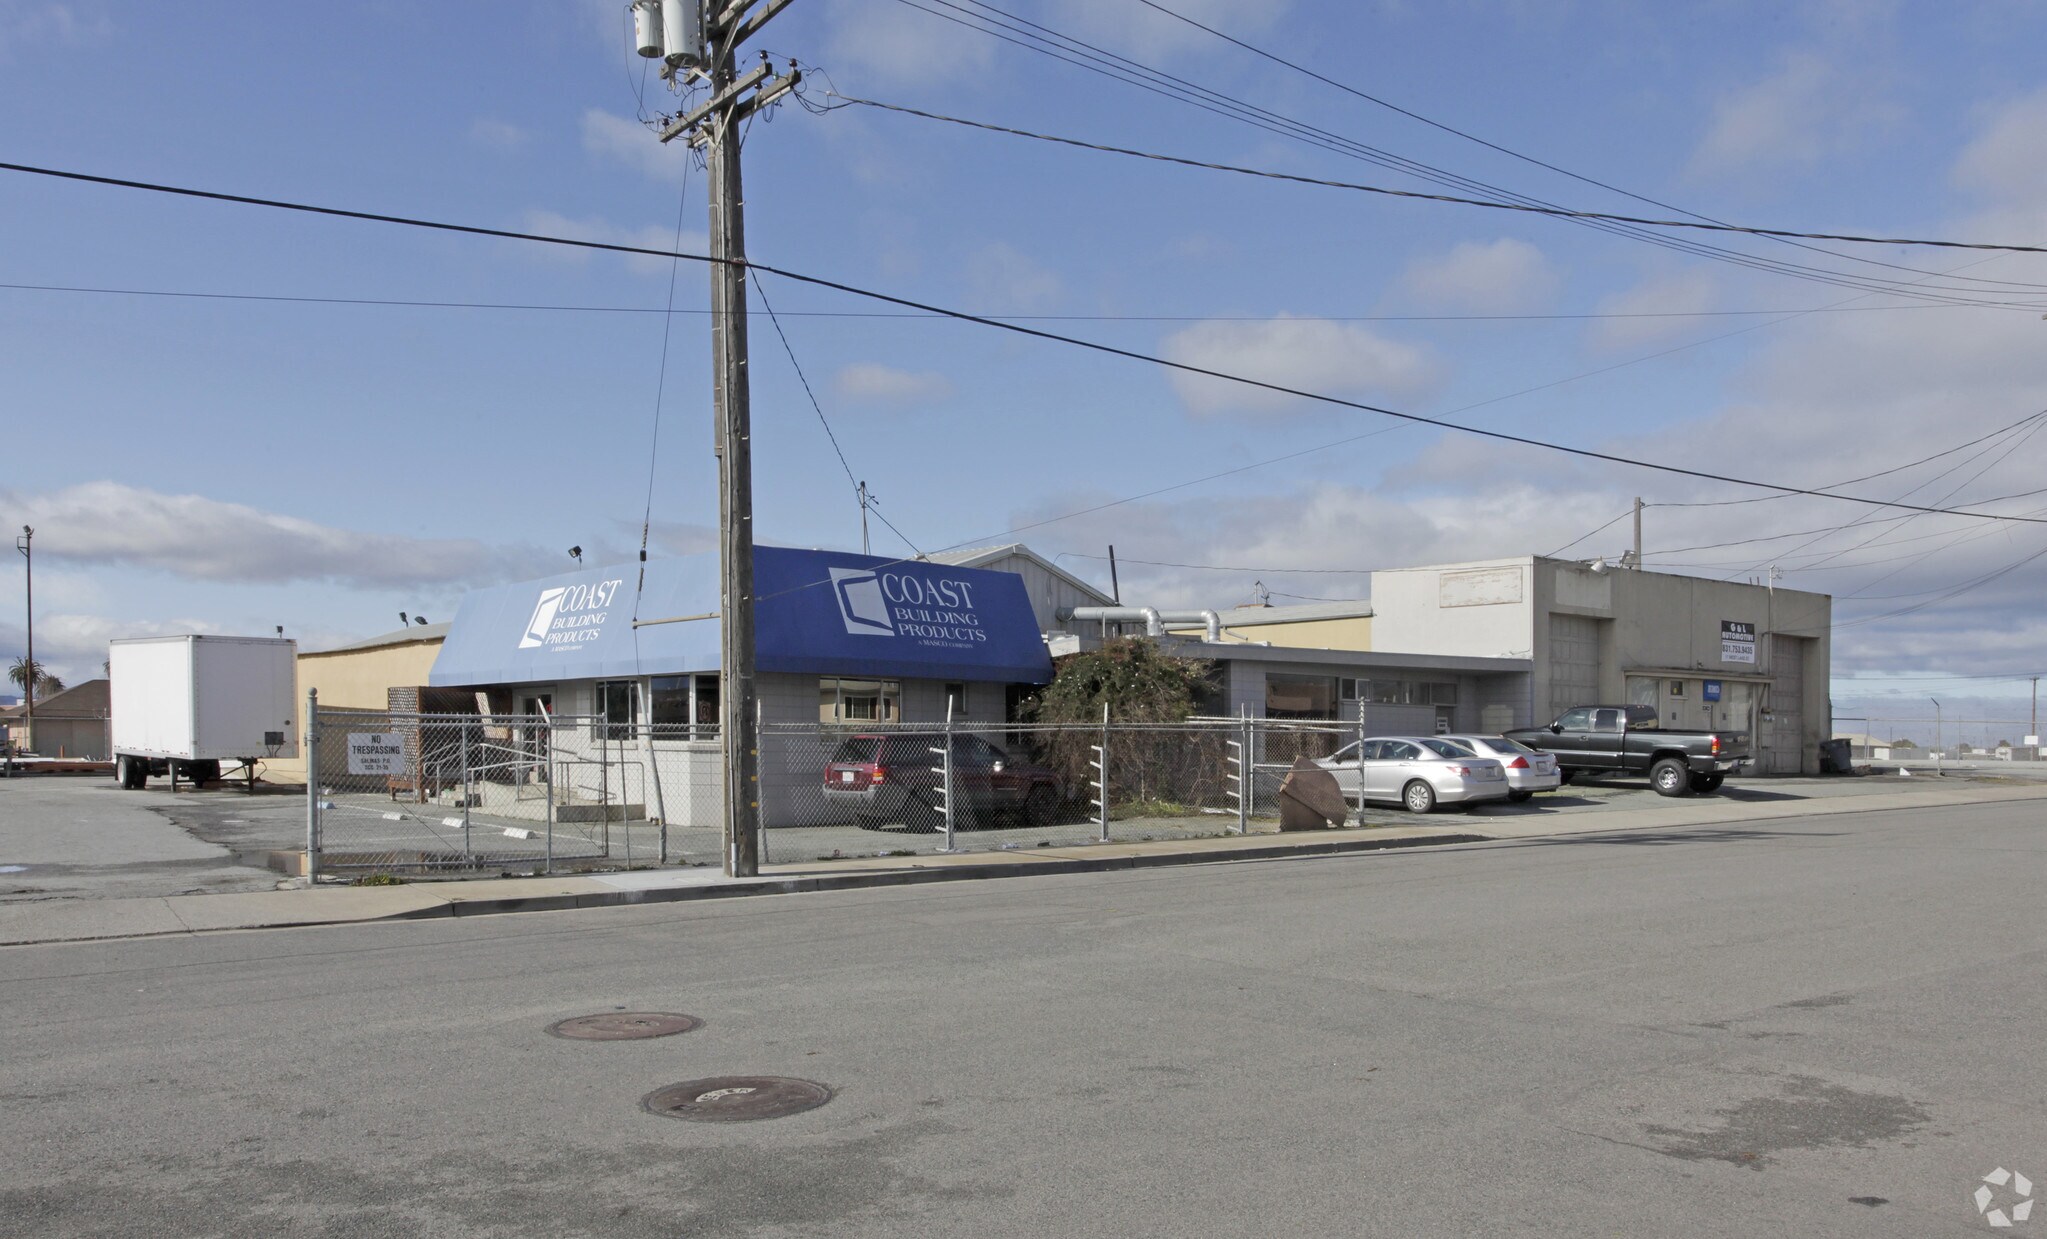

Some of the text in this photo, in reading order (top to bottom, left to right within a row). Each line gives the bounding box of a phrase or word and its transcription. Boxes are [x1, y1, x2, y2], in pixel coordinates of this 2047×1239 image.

[560, 579, 622, 613] COAST
[882, 573, 973, 609] COAST
[552, 612, 607, 629] BUILDING
[894, 607, 979, 626] BUILDING
[897, 622, 987, 642] PRODUCTS
[1730, 623, 1736, 632] G
[545, 628, 601, 645] PRODUCTS
[1721, 631, 1754, 642] AUTOMOTIVE
[371, 735, 382, 744] NO
[352, 745, 400, 755] TRESPASSING
